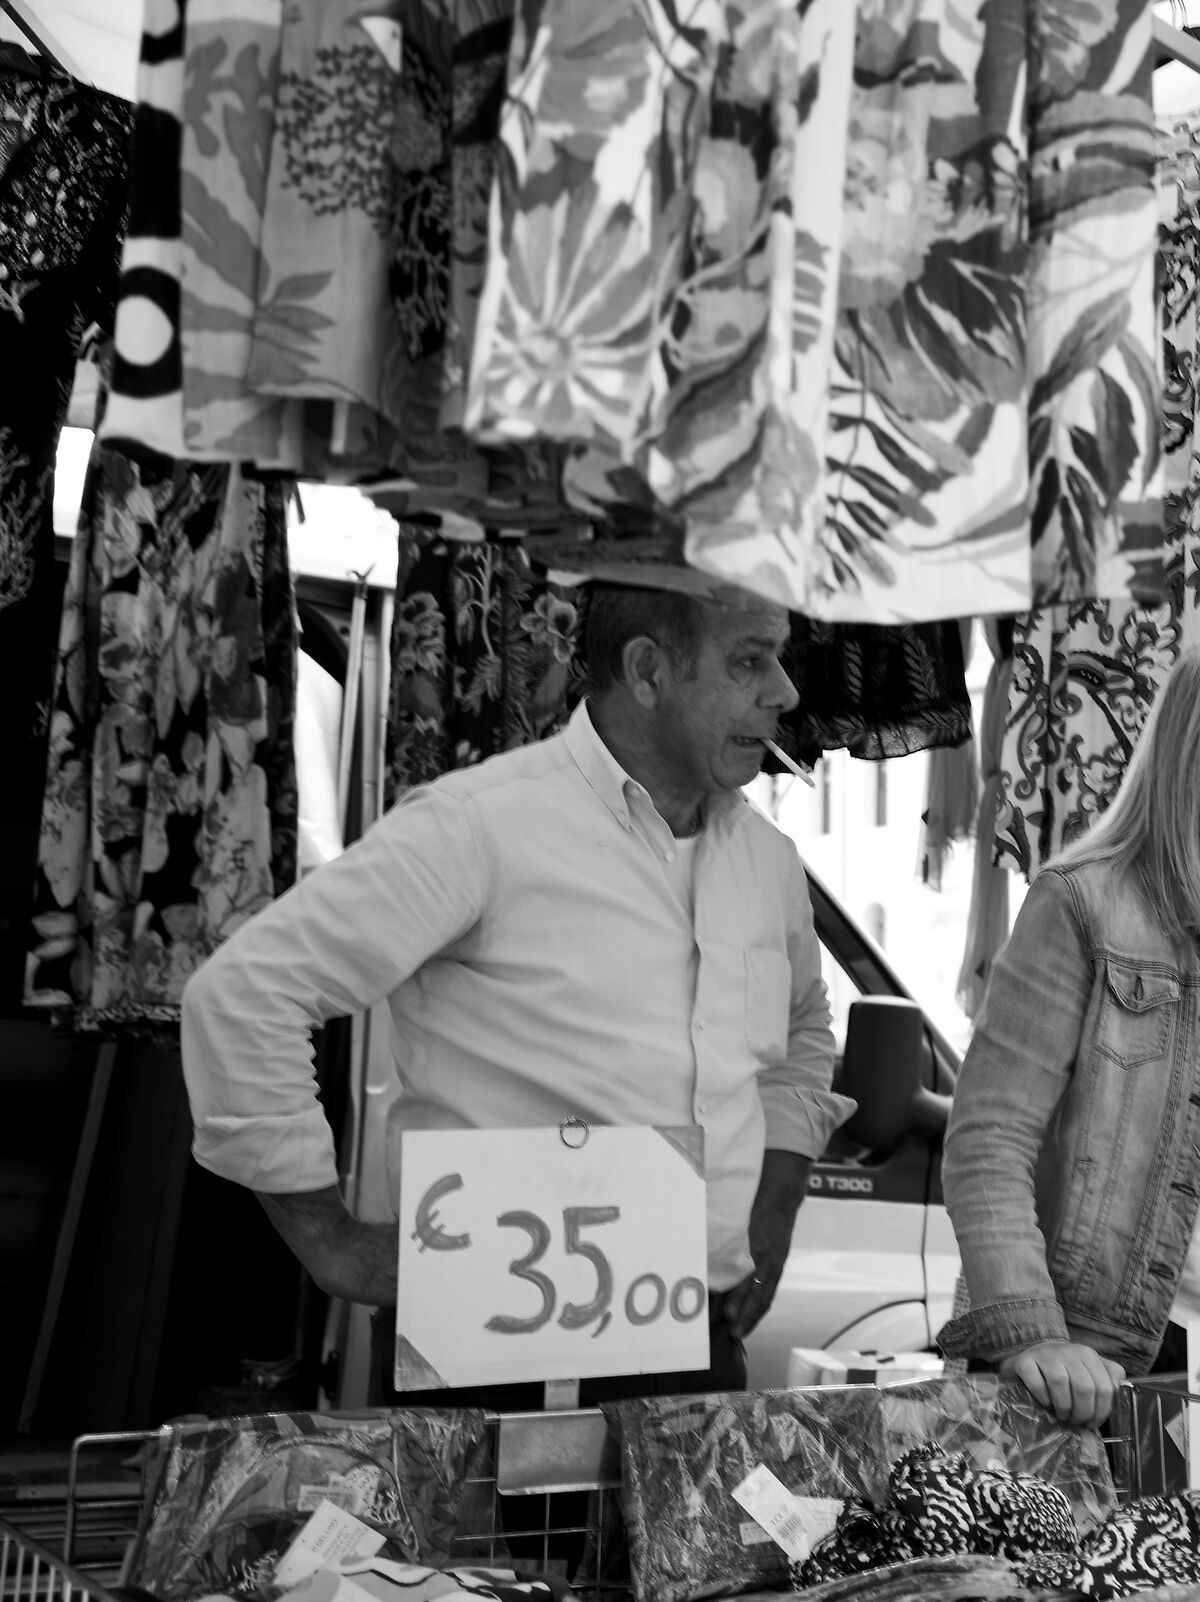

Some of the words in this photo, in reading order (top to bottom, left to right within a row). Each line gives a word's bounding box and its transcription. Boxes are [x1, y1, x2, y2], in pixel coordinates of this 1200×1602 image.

[825, 1175, 873, 1192] T300
[411, 1172, 472, 1254] €
[483, 1205, 706, 1340] 35,00
